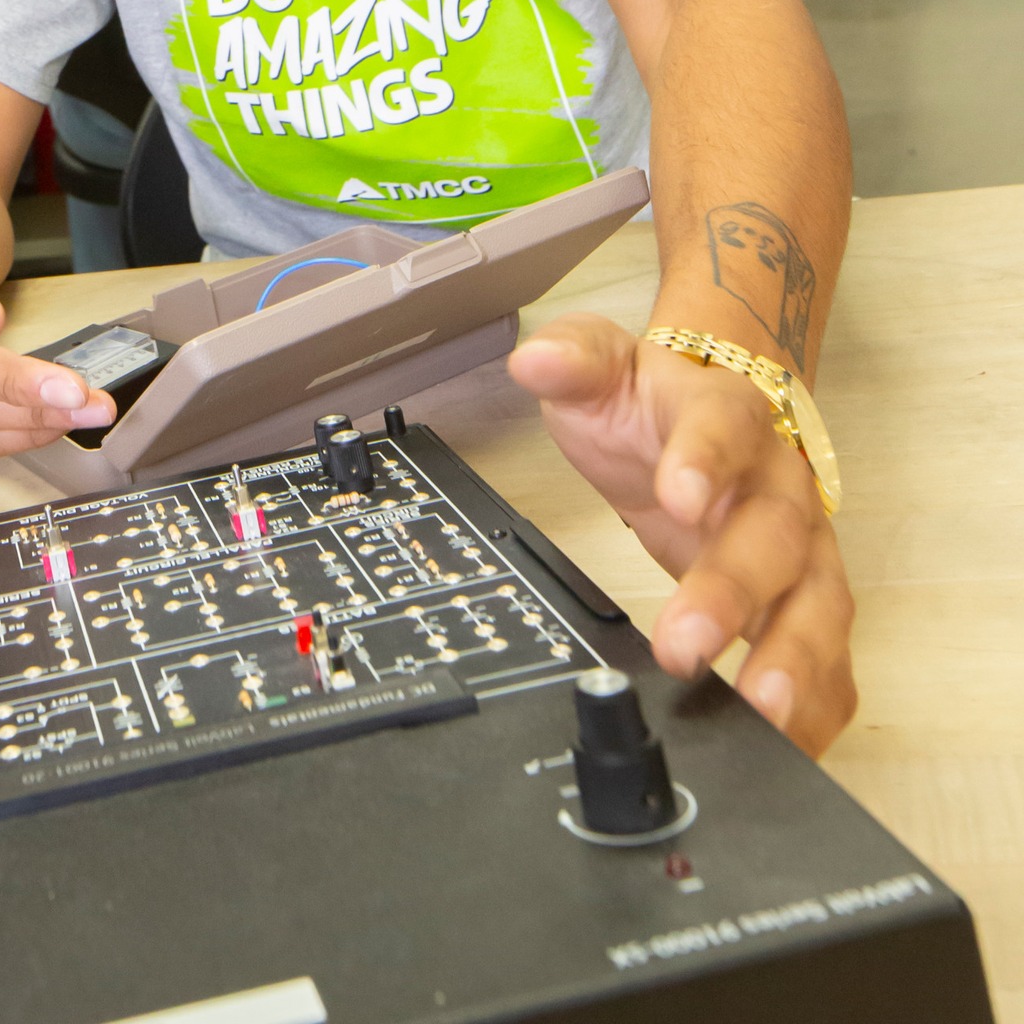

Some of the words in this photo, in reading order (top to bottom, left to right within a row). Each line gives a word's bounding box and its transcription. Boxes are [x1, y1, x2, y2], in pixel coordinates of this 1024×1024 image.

[225, 58, 455, 140] THINGS
[377, 176, 493, 201] TMCC
[80, 493, 148, 512] VOLTAGE
[19, 509, 76, 525] DIVDER
[125, 558, 186, 576] CIRCUIT
[269, 689, 405, 728] Fundamentals
